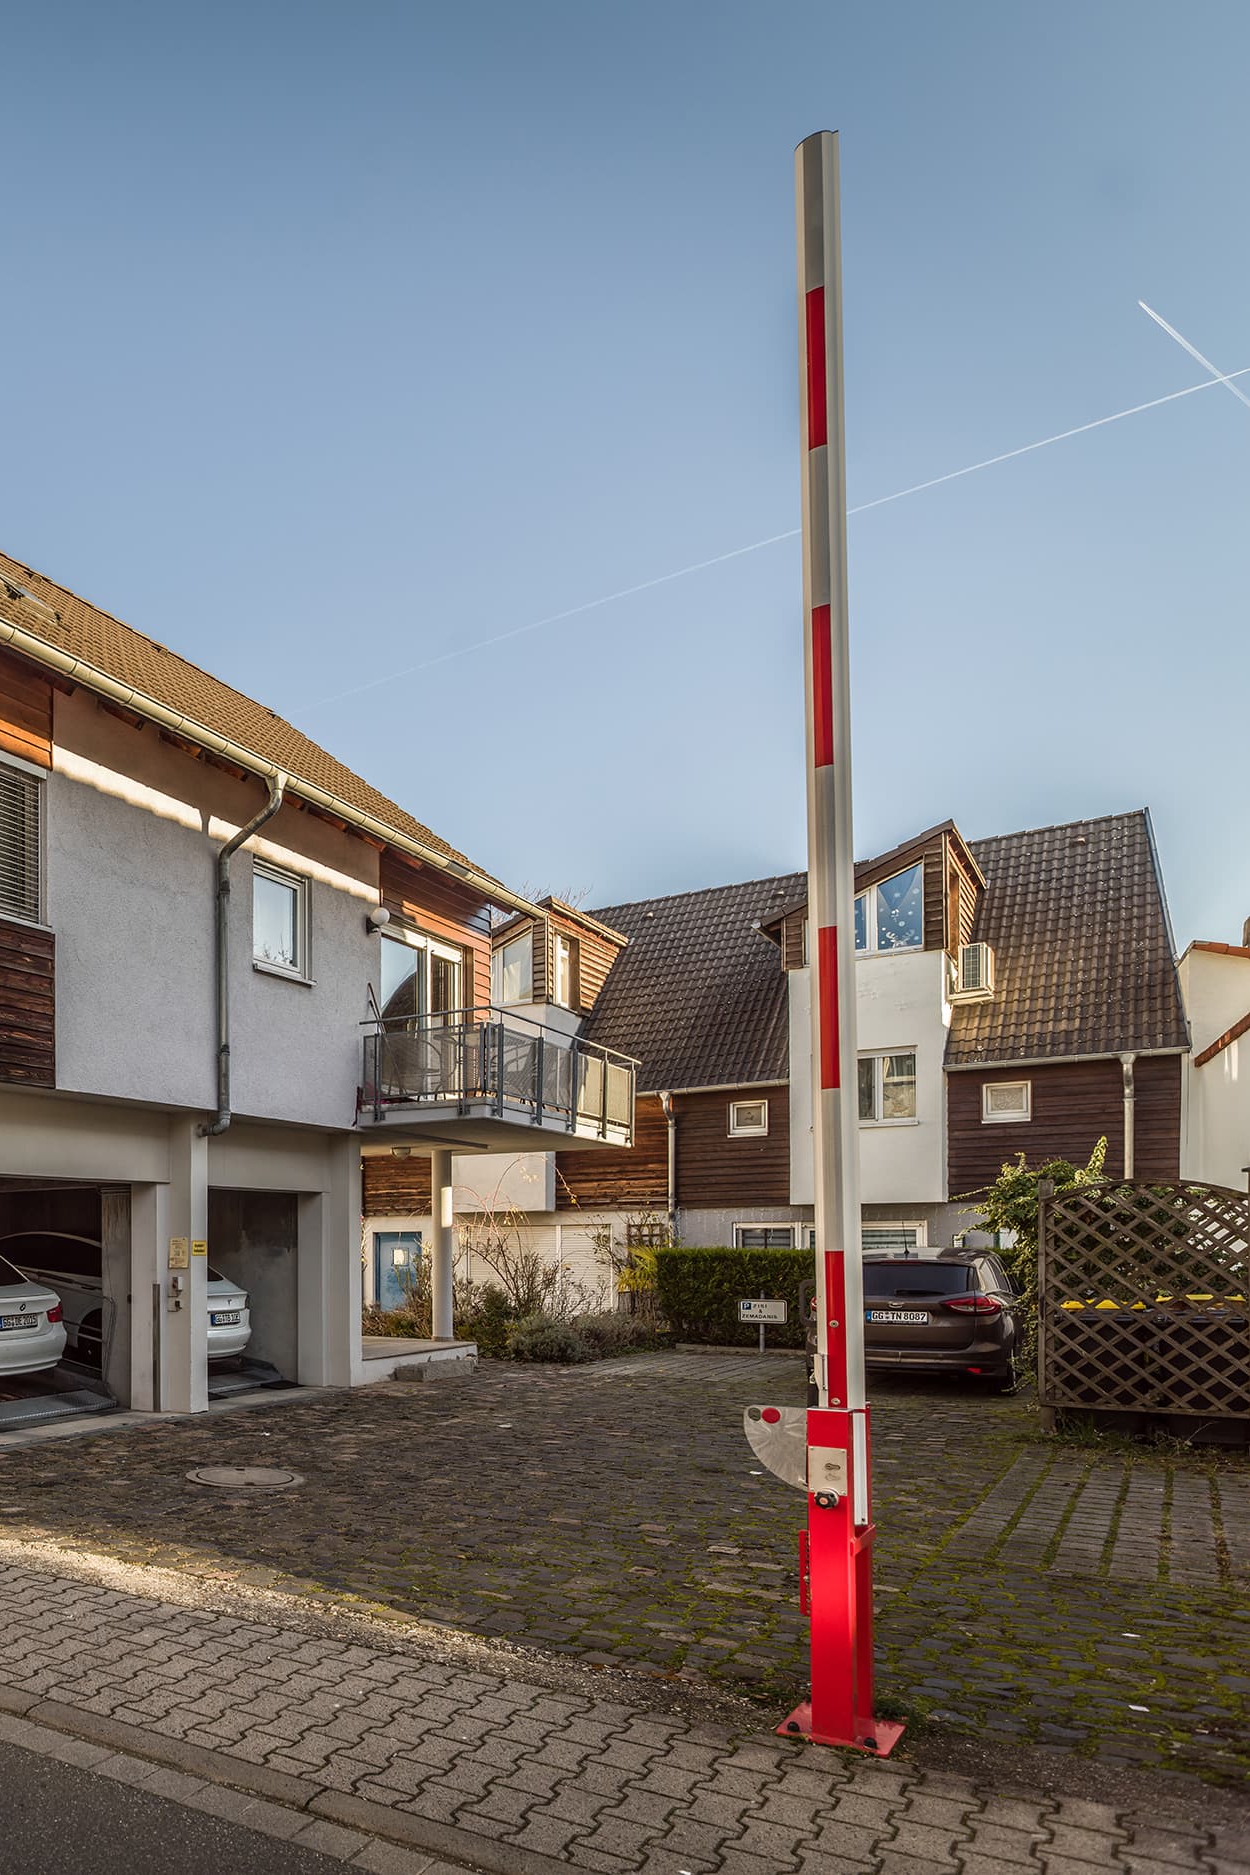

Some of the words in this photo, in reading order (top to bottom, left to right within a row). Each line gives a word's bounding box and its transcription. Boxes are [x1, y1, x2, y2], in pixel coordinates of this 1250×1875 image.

[872, 1311, 884, 1320] GG
[891, 1312, 902, 1320] TN
[903, 1312, 926, 1321] 8087
